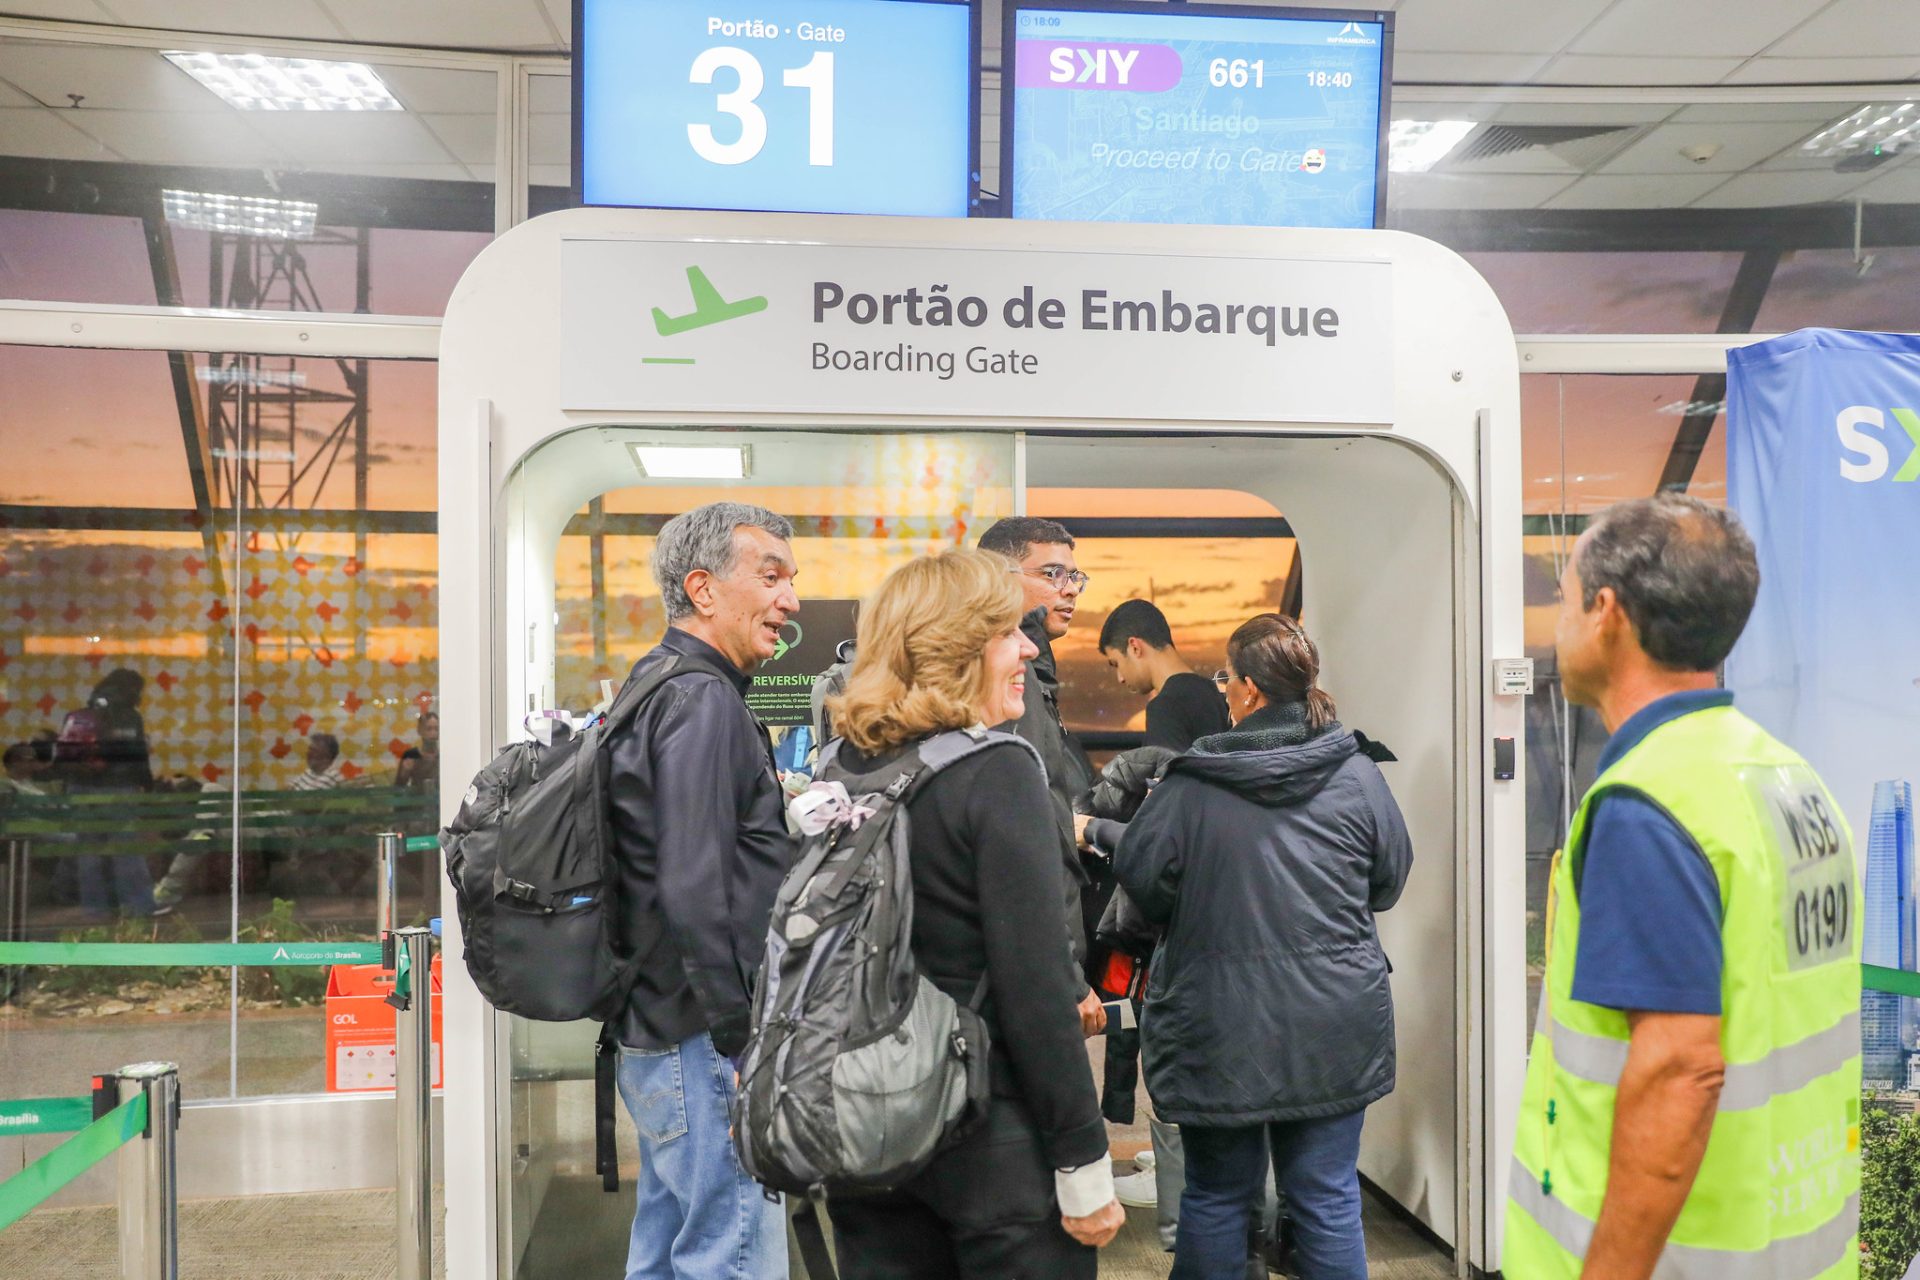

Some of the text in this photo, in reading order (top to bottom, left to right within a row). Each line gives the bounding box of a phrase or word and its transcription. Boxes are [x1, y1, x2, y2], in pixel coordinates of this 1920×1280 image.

[708, 17, 846, 43] Portão Gate
[1034, 17, 1061, 27] 18:09
[1327, 37, 1376, 45] INFRAMERICA
[1050, 47, 1139, 84] SKY
[1208, 57, 1265, 89] 661
[1306, 71, 1352, 88] 18:40
[687, 46, 834, 167] 31
[1135, 106, 1260, 138] Santiago
[1091, 142, 1302, 172] Proceed to Gate
[813, 282, 1339, 347] Portão de Embarque
[813, 342, 1039, 381] Boarding Gate
[753, 673, 817, 686] REVERSÍVE
[1794, 882, 1848, 955] 0190
[291, 952, 324, 960] Aeroporto
[333, 1014, 358, 1024] GOL
